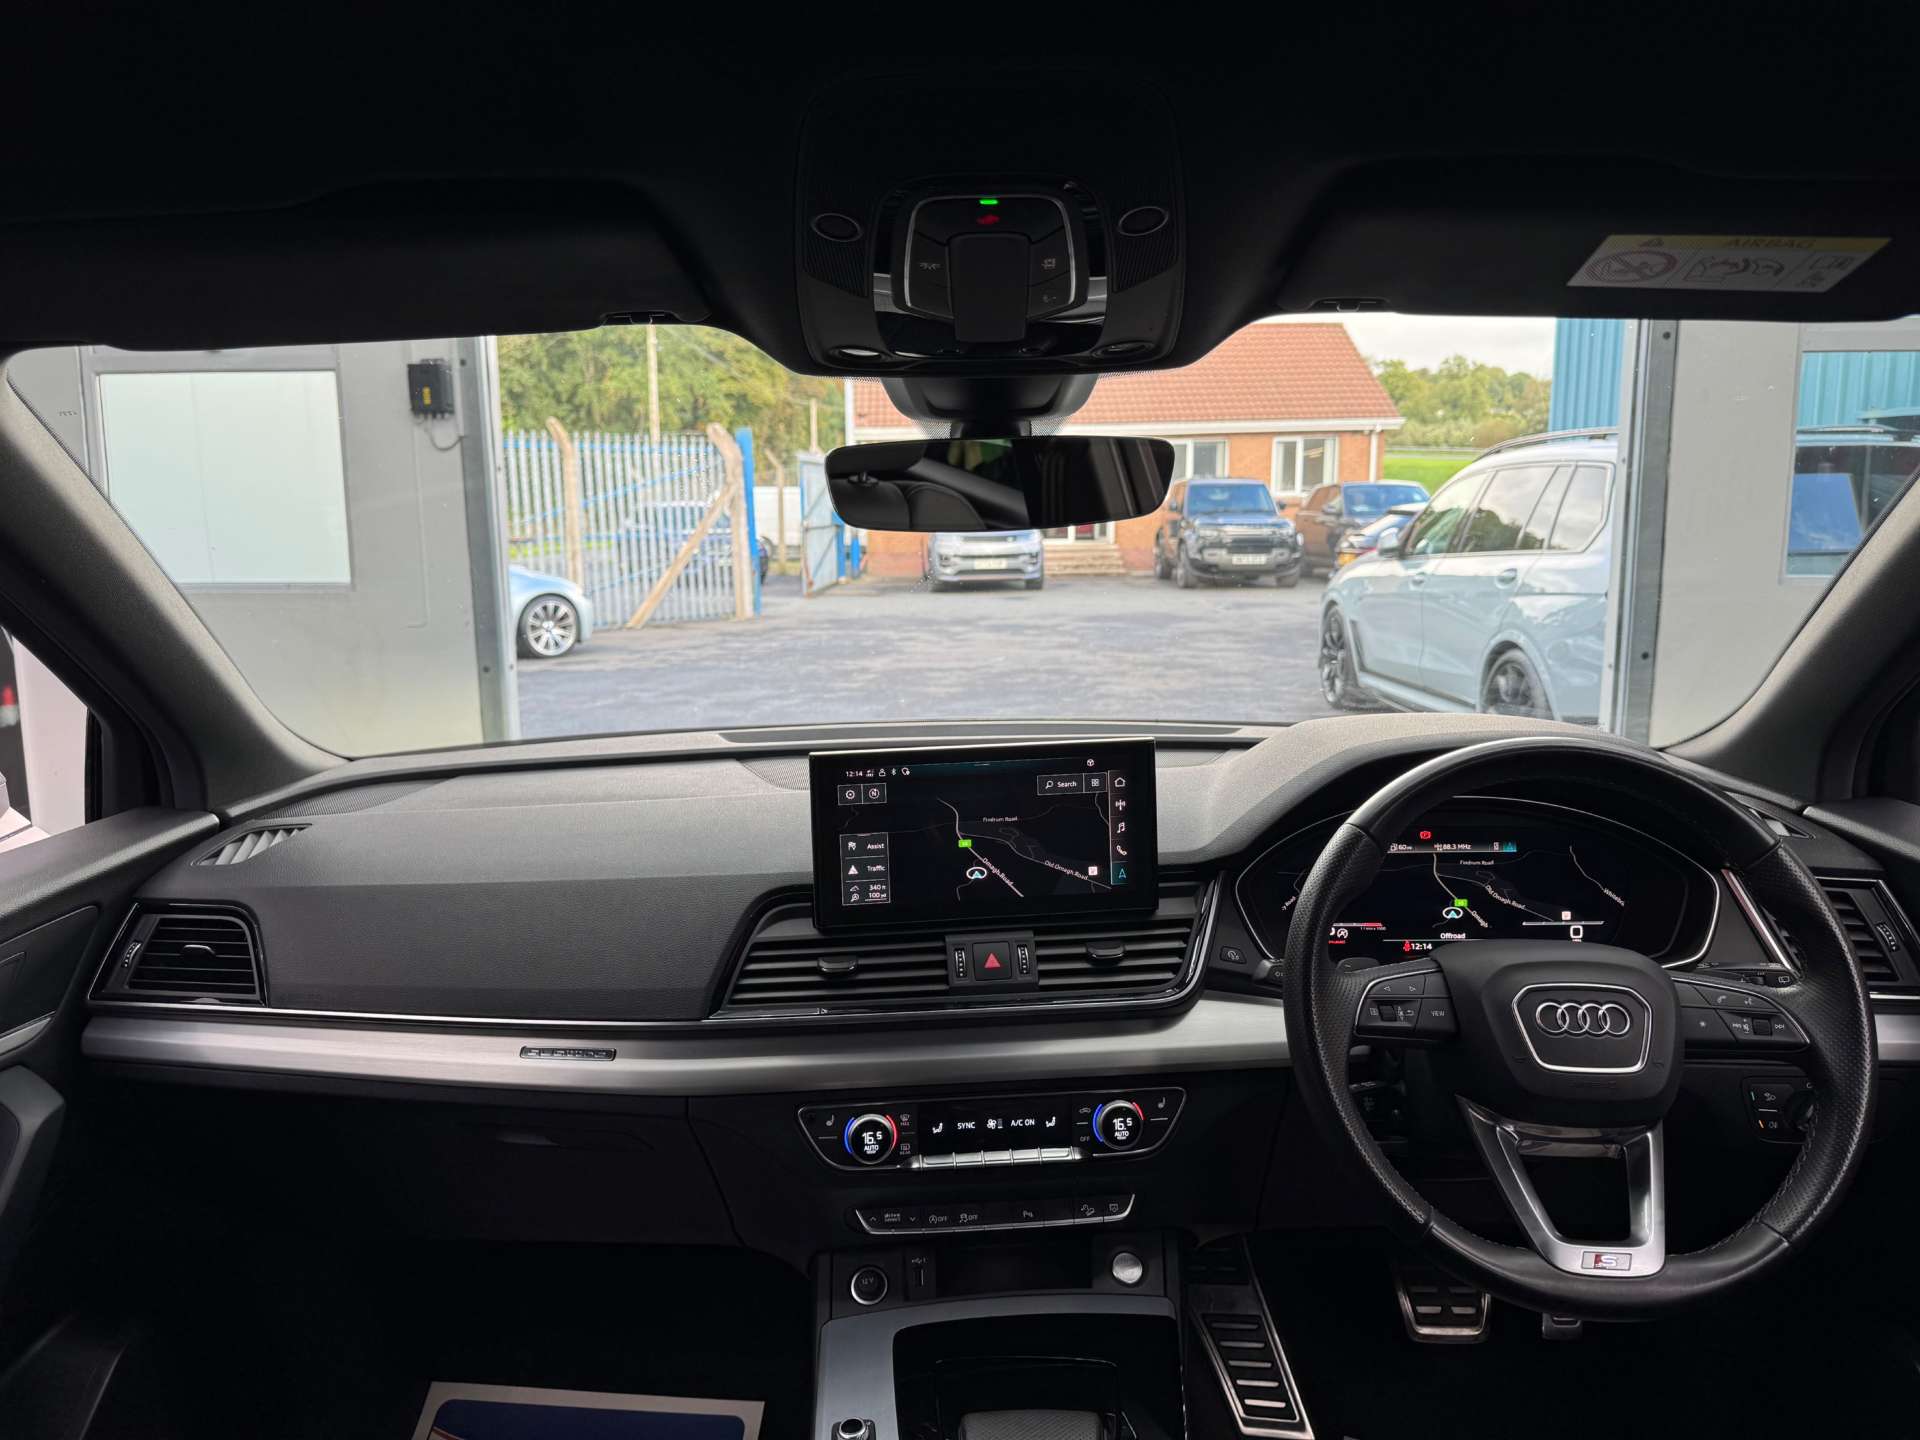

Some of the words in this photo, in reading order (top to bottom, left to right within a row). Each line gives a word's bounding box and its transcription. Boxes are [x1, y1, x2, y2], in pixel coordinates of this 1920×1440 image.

[1724, 238, 1816, 249] AIRBAG
[867, 864, 886, 872] Traffic
[957, 1121, 976, 1130] SYNC
[1010, 1119, 1024, 1127] A/C
[1024, 1118, 1036, 1126] ON
